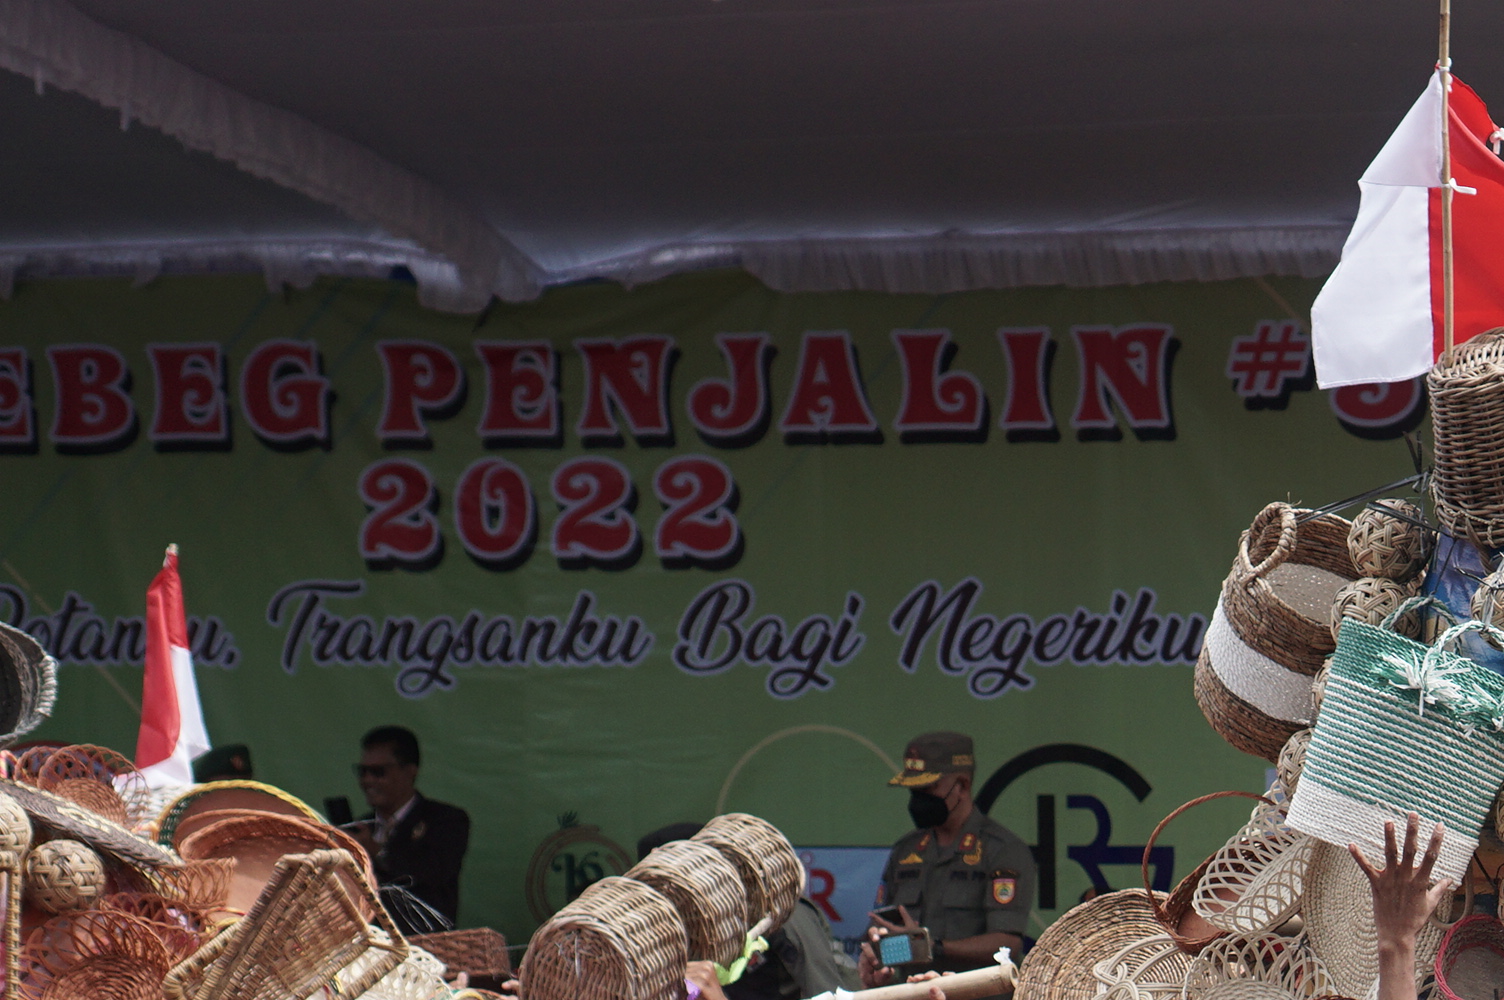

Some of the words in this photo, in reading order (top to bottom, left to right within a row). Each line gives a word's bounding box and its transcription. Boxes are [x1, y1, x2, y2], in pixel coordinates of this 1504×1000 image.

[374, 323, 1174, 438] PENJALIN
[358, 454, 740, 560] 2022
[0, 583, 241, 669] otanu,
[267, 580, 653, 698] Trangsanku
[673, 577, 866, 699] Bagi
[890, 575, 1207, 698] Negeriku
